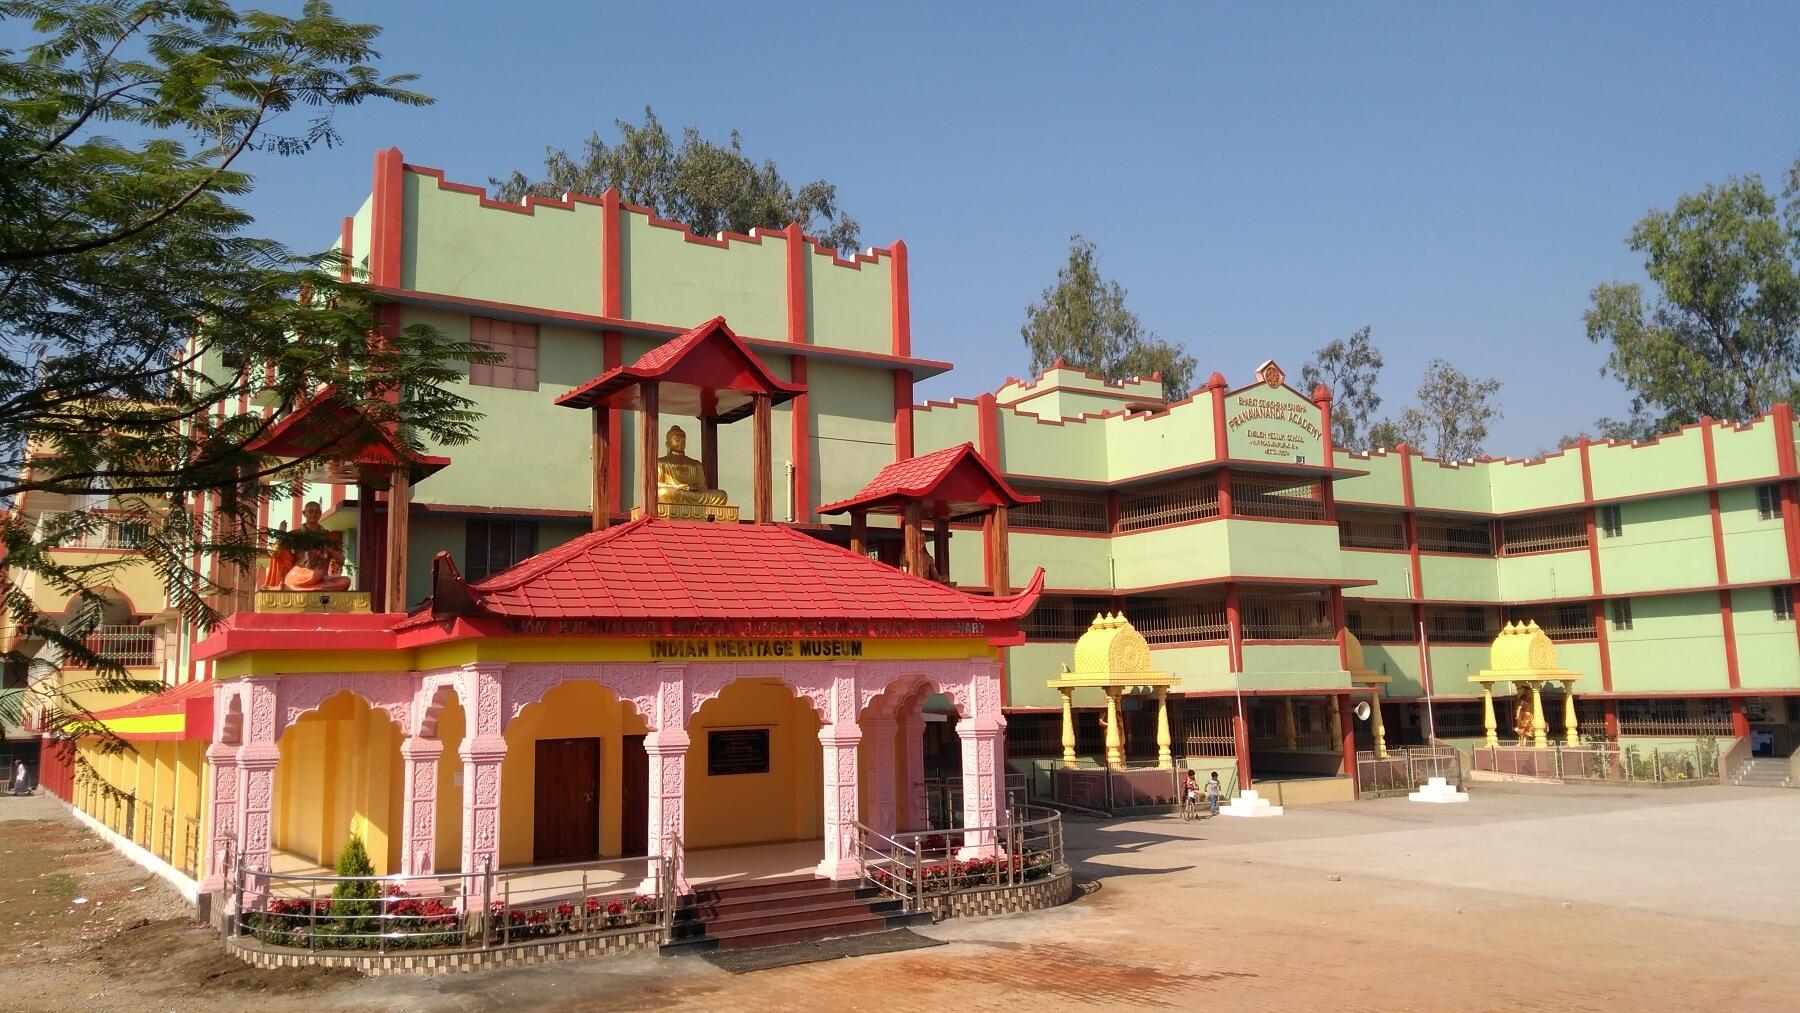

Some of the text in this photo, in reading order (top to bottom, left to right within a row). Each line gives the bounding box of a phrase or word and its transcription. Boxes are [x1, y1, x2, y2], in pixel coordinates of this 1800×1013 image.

[1228, 407, 1322, 441] PRANAVANANDA ACADEMY
[650, 639, 863, 658] INDIAN HERITAGE MUSEUM
